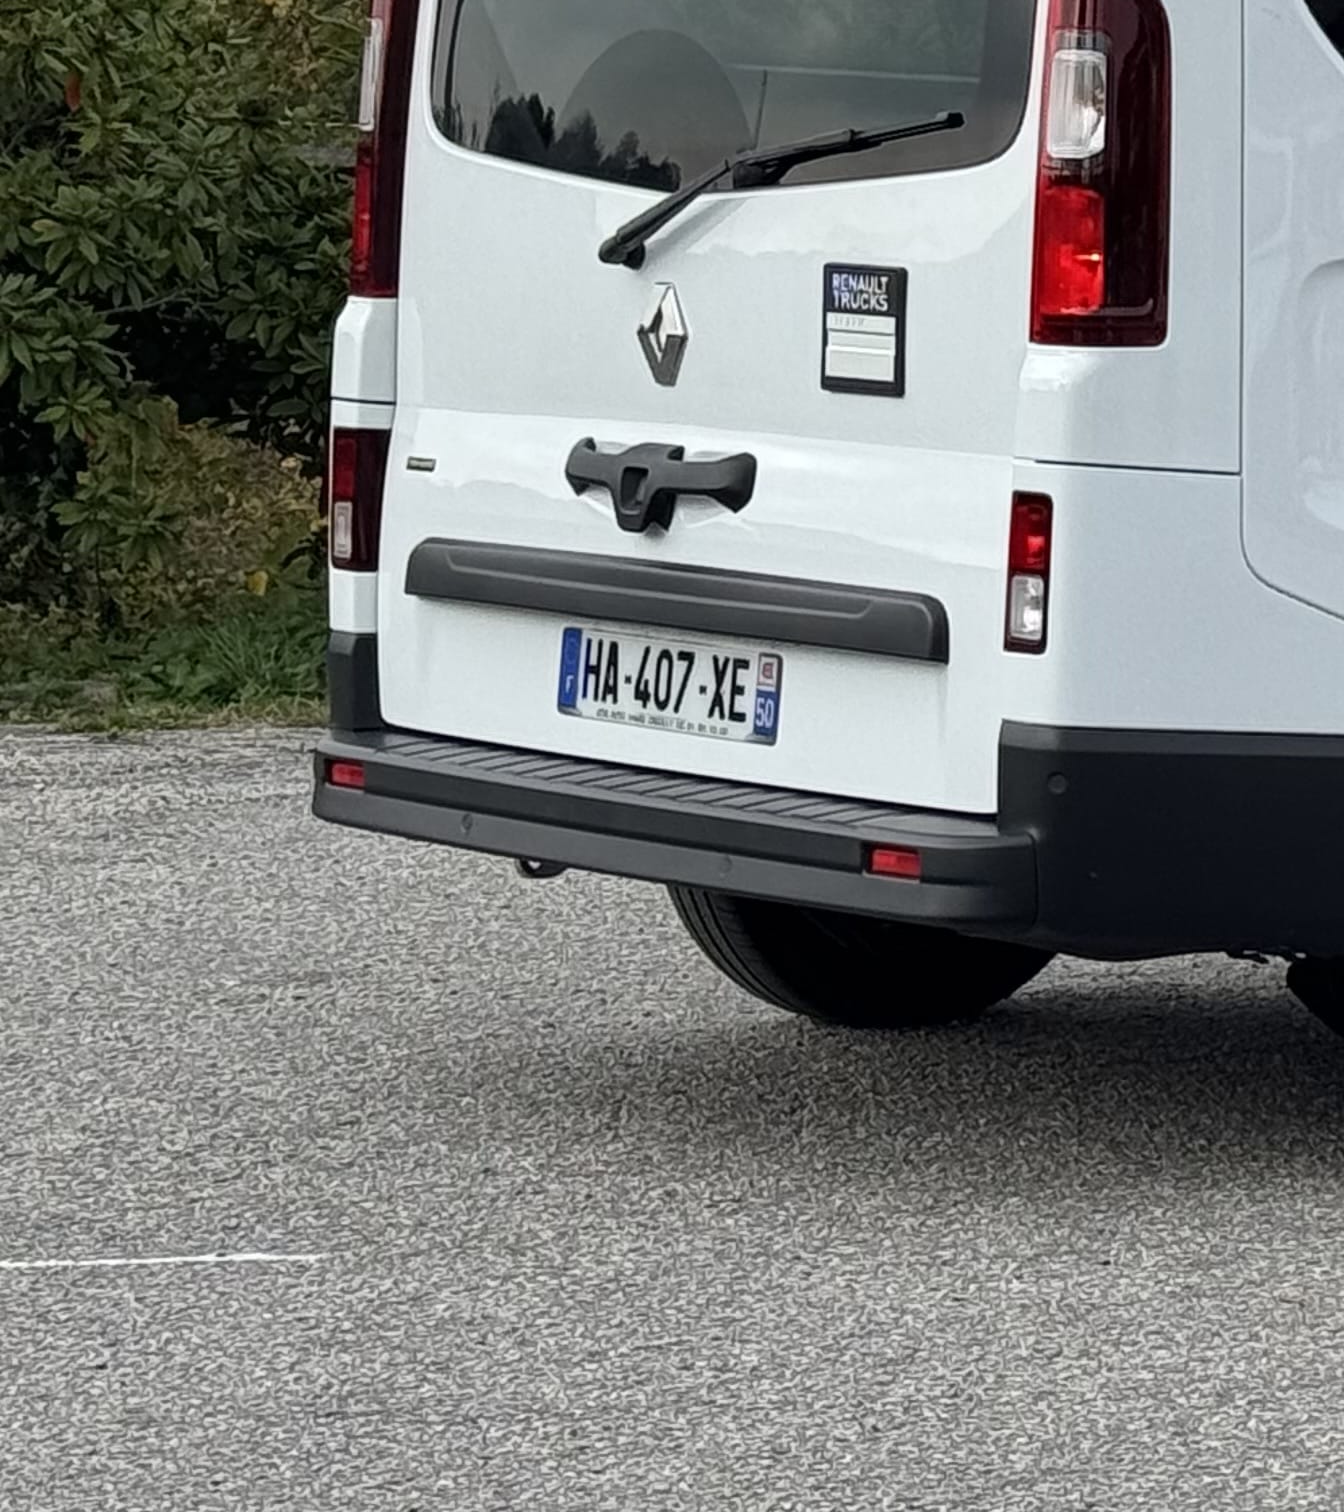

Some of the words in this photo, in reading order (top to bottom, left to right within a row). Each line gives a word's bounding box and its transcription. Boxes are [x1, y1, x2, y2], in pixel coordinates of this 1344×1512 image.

[832, 273, 889, 294] RENAULT
[832, 289, 889, 312] TRUCKS
[581, 637, 750, 723] HA-407-XE
[755, 696, 775, 729] 50
